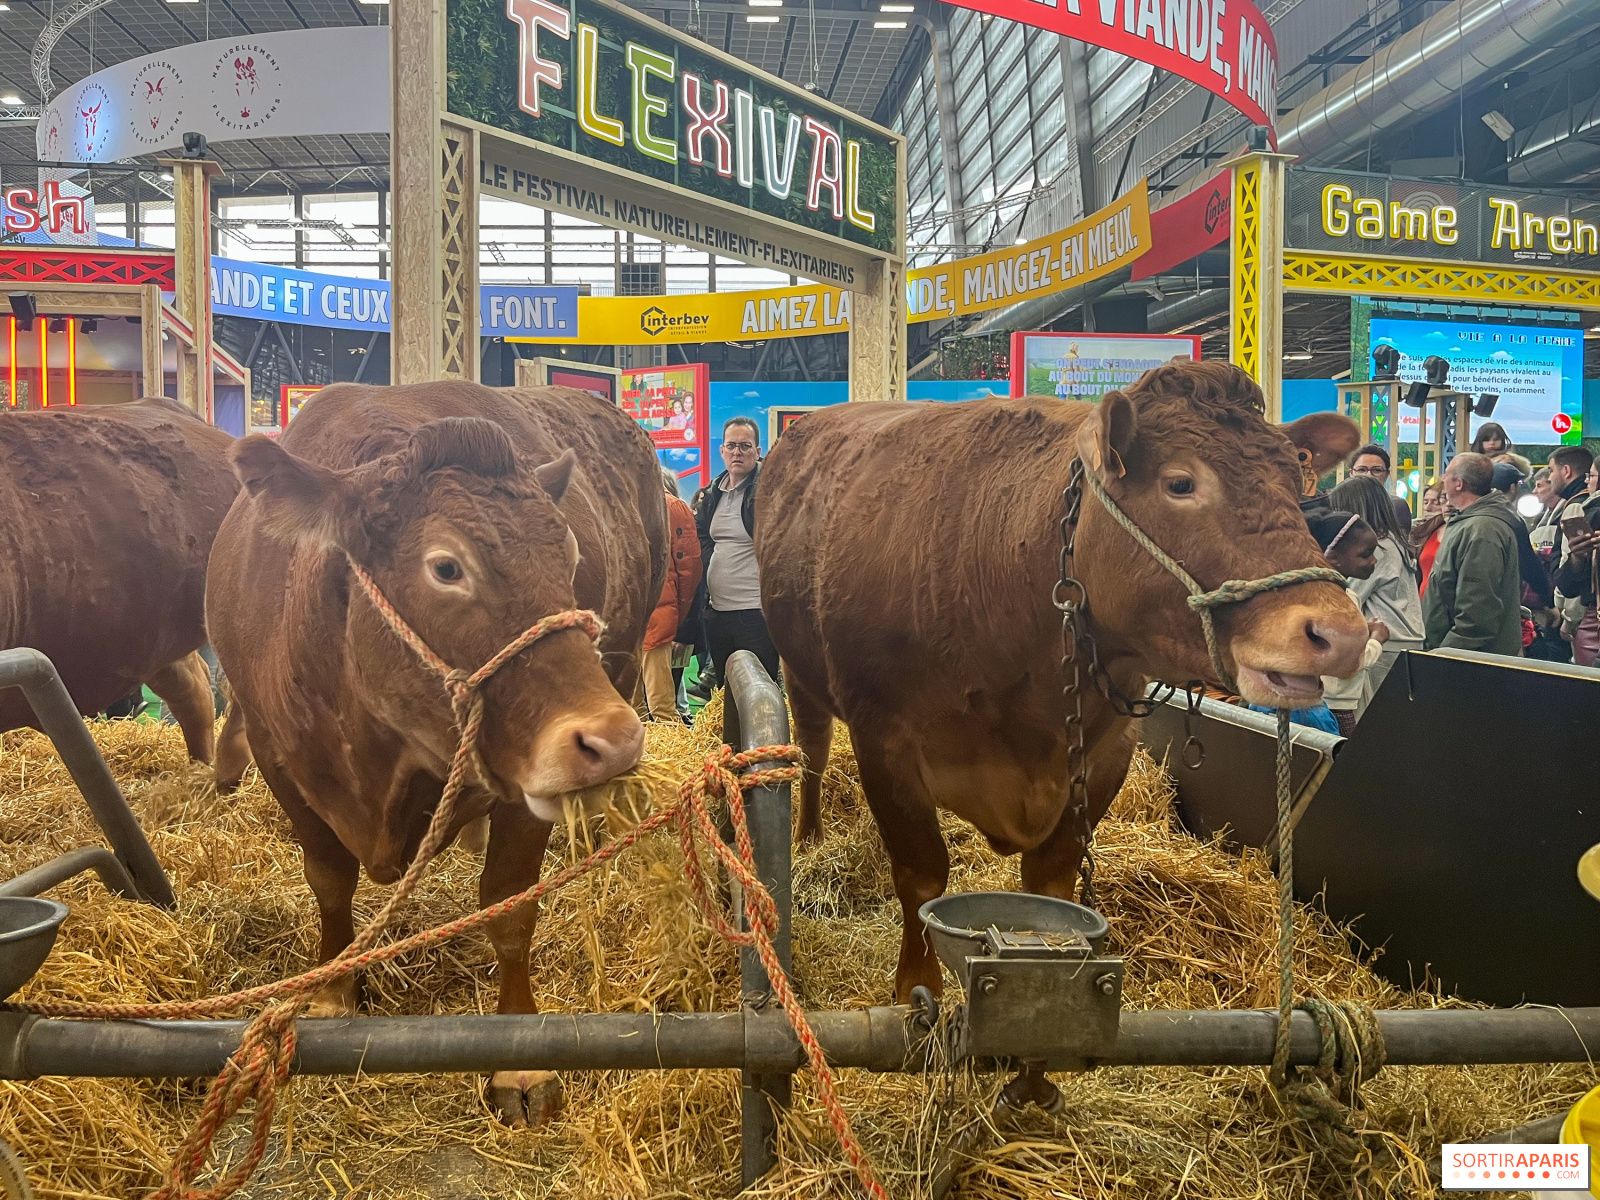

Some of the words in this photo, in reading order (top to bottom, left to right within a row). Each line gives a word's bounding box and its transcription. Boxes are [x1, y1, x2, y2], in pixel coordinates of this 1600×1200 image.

[212, 44, 280, 78] NATURELLEMENT
[130, 61, 183, 96] NATURELLEMENT
[212, 98, 280, 130] FLEXITARIENS
[507, 0, 876, 233] FLEXIVAL
[480, 160, 508, 190] LE
[513, 169, 610, 218] FESTIVAL
[614, 199, 854, 285] NATURELLEMENT-FLEXITARIENS
[1321, 183, 1459, 245] Game
[963, 231, 1085, 306] MANGEZ-EN
[1087, 204, 1138, 272] MIEUX.
[283, 277, 314, 316] ET
[320, 284, 390, 324] CEUX
[490, 295, 567, 330] FONT.
[740, 294, 818, 334] AIMEZ
[647, 313, 710, 327] interbev
[1458, 331, 1485, 343] VIE
[1067, 371, 1095, 382] BOUT
[1097, 371, 1112, 382] DU
[1467, 365, 1478, 373] les
[1480, 367, 1509, 375] paysans
[1485, 357, 1495, 365] de
[1496, 357, 1508, 365] vie
[1525, 359, 1555, 367] animaux
[1072, 384, 1101, 395] BOUT
[1453, 375, 1470, 383] pour
[1472, 375, 1511, 384] bénéficier
[1503, 387, 1546, 395] notamment
